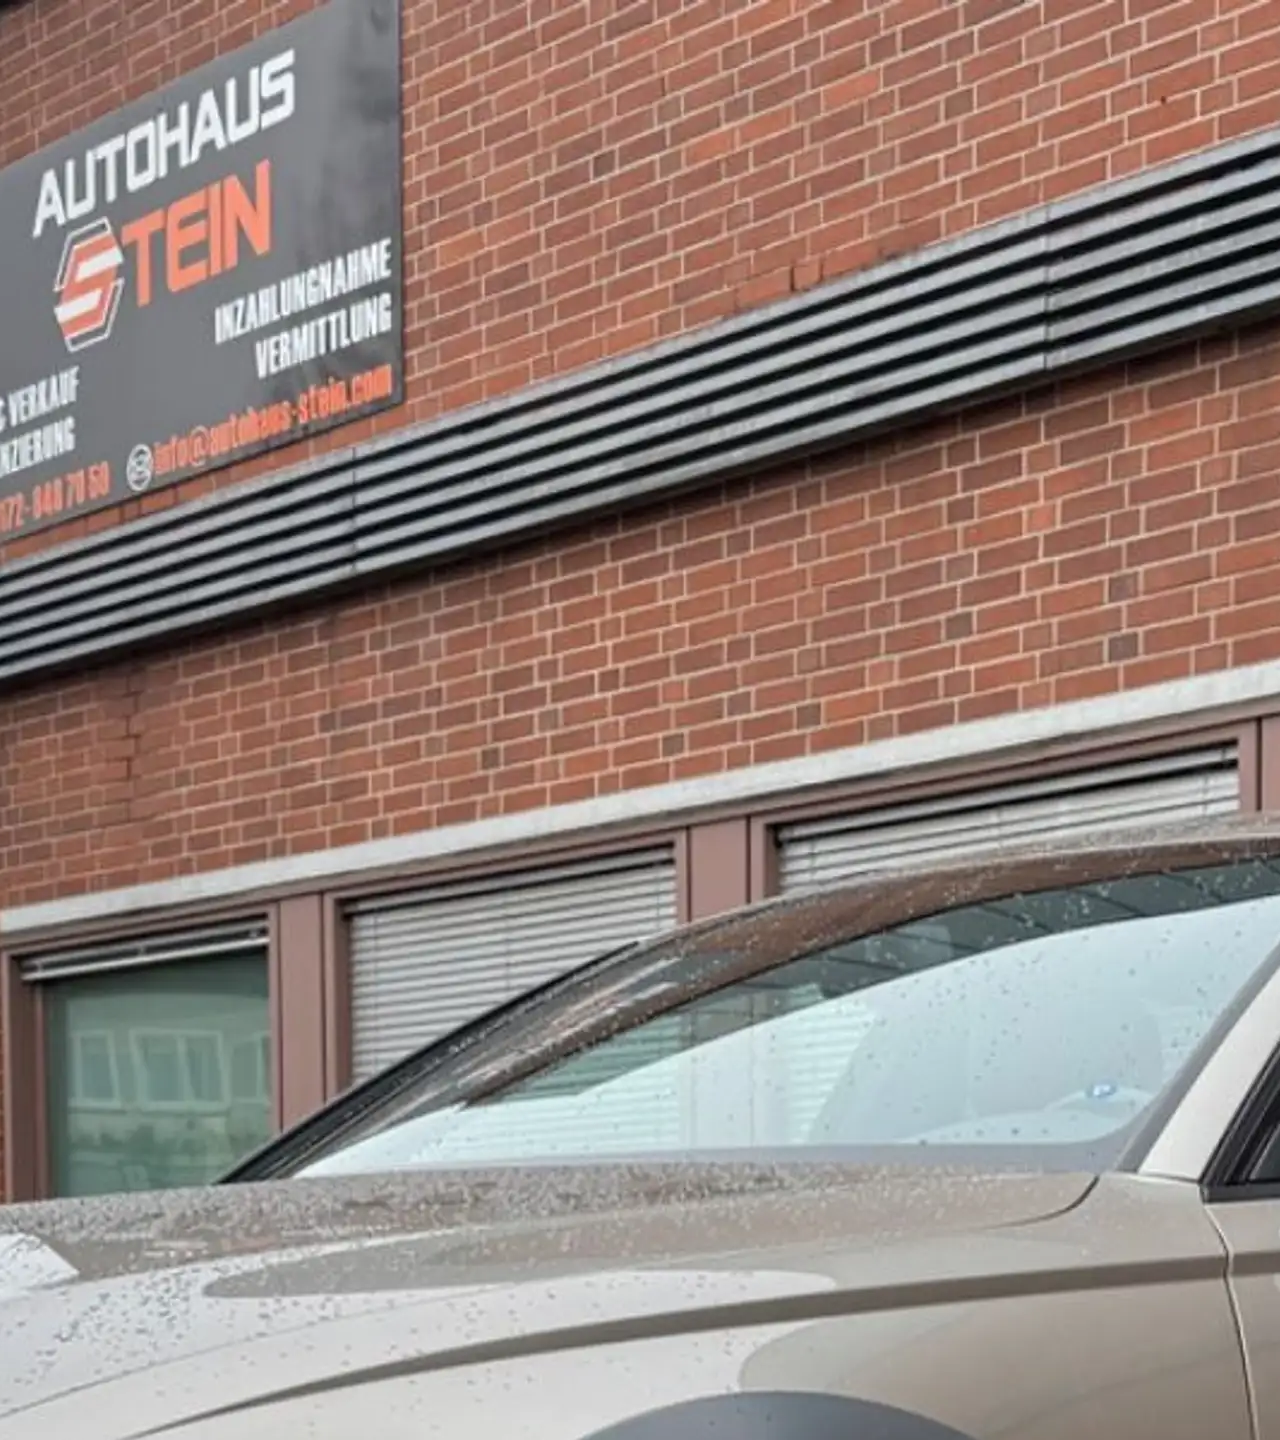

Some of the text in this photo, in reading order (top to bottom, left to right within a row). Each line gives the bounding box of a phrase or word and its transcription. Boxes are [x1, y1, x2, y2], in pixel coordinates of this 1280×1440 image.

[32, 49, 295, 238] AUTOHAUS
[215, 237, 392, 344] INZAHLUNGNAHME
[256, 292, 392, 380] VERMITTLUNG
[8, 365, 80, 427] VERKAUF
[153, 364, 392, 475] info@autohaus-stein.com
